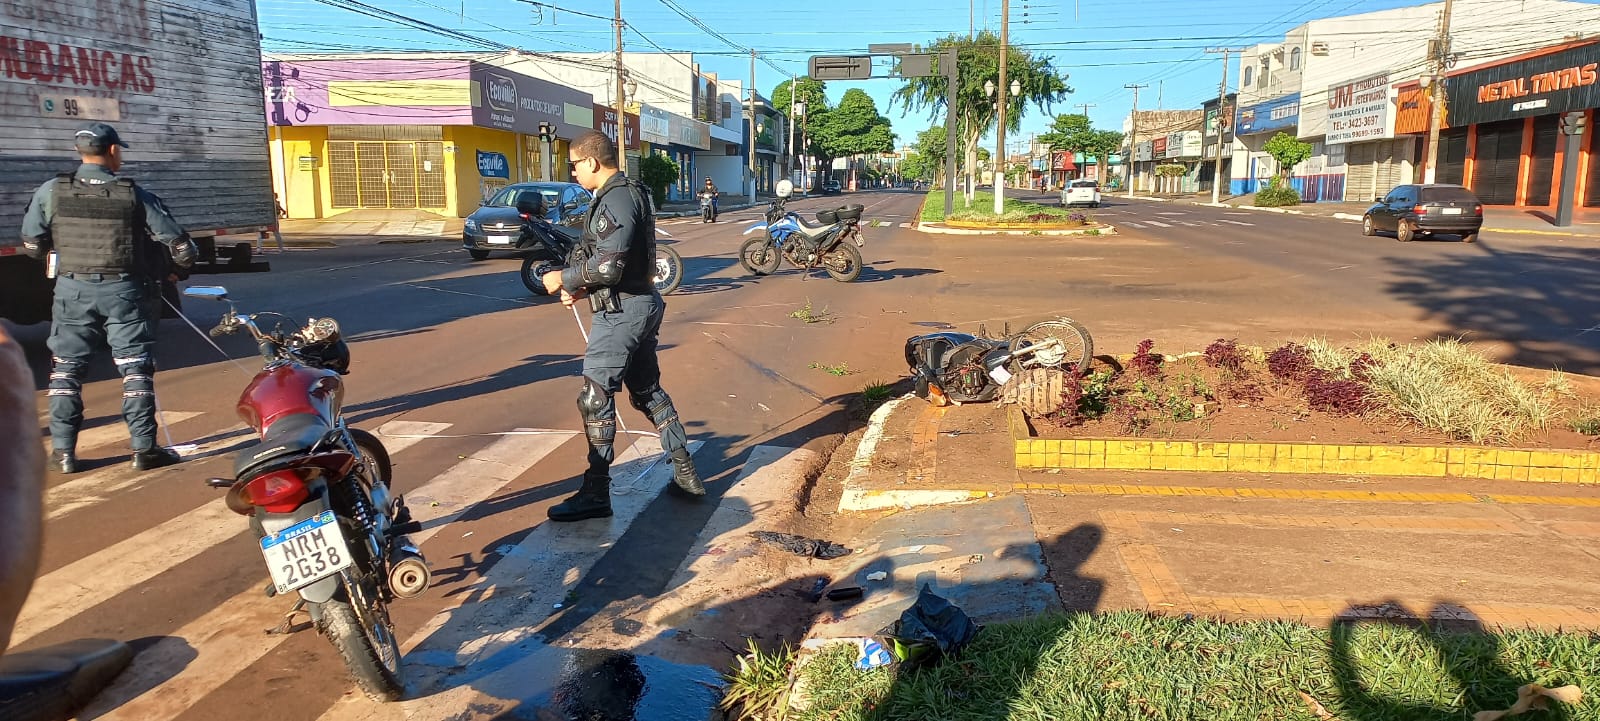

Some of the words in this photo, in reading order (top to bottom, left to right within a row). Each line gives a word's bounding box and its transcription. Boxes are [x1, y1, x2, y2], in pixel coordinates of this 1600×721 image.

[489, 81, 515, 103] Ecoville
[1356, 76, 1388, 90] PRODUTOS
[1477, 77, 1529, 104] METAL
[1530, 62, 1598, 94] TINTAS
[64, 98, 79, 116] 99
[1328, 83, 1353, 110] JM
[601, 121, 633, 146] NAPLY
[478, 153, 504, 170] Ecoville
[284, 525, 313, 540] BRASIL
[281, 527, 328, 562] NRM
